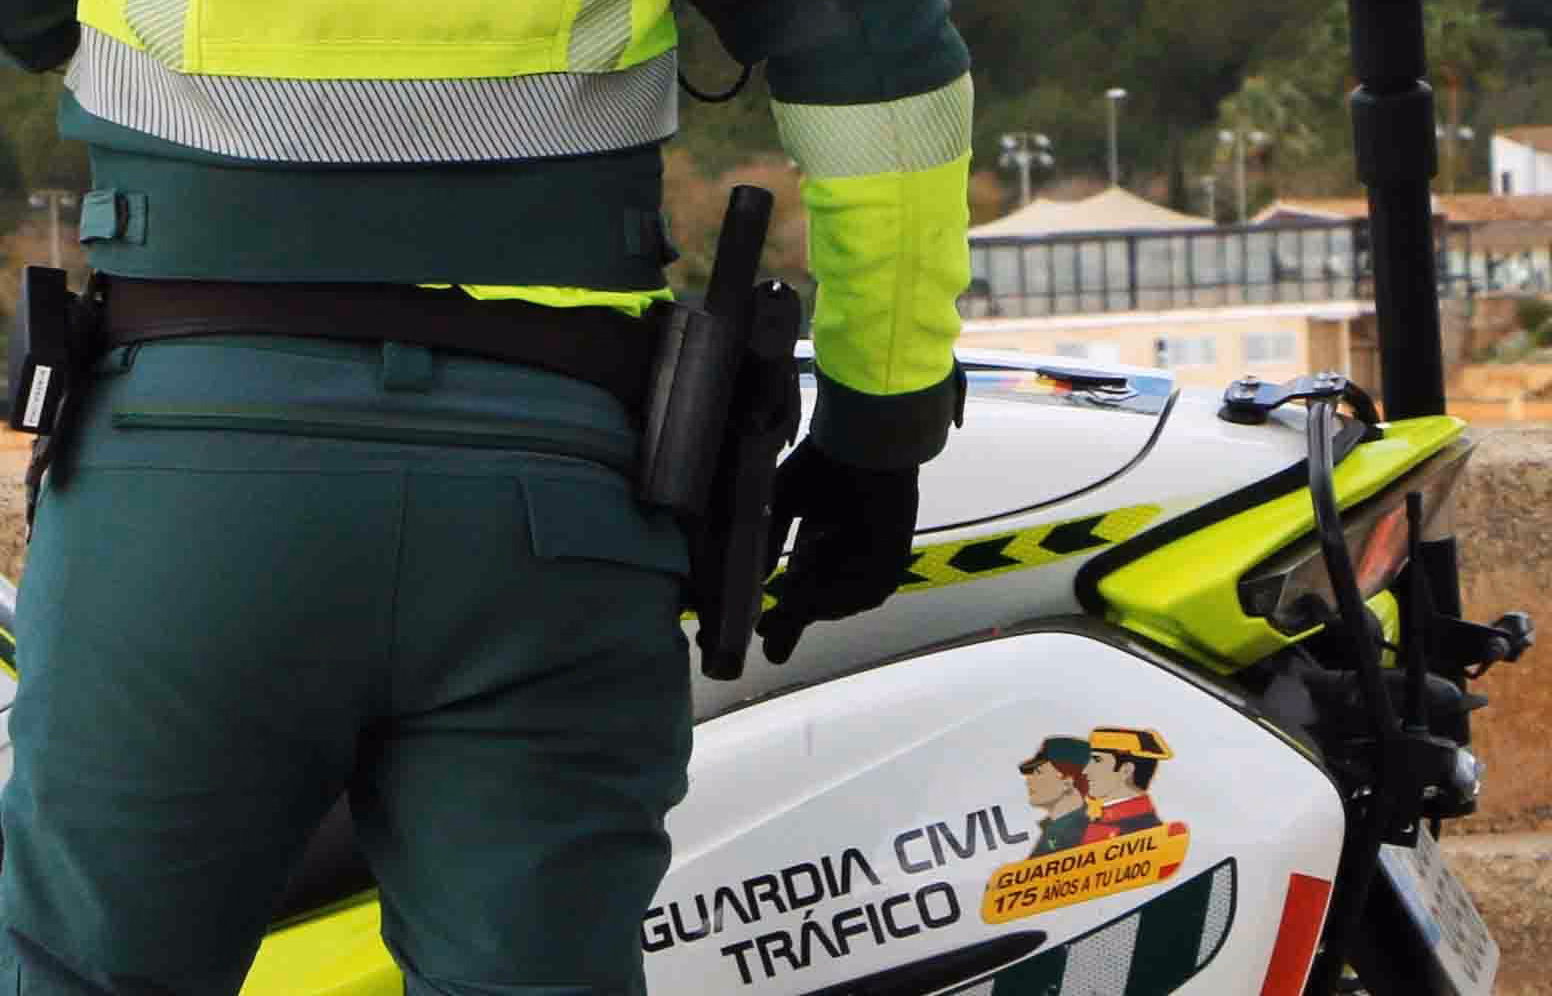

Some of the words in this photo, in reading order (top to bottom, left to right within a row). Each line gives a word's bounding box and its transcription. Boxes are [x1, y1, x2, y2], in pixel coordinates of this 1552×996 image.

[640, 848, 882, 953] GUARDIA
[893, 805, 1030, 875] CIVIL
[994, 887, 1039, 914] 175
[1041, 879, 1079, 901] AÑOS
[1080, 876, 1091, 894] A
[1095, 871, 1114, 889] TU
[1114, 860, 1151, 884] LADO
[997, 851, 1097, 890] GUARDIA
[1104, 836, 1158, 861] CIVIL
[721, 881, 961, 985] TRÁFICO
